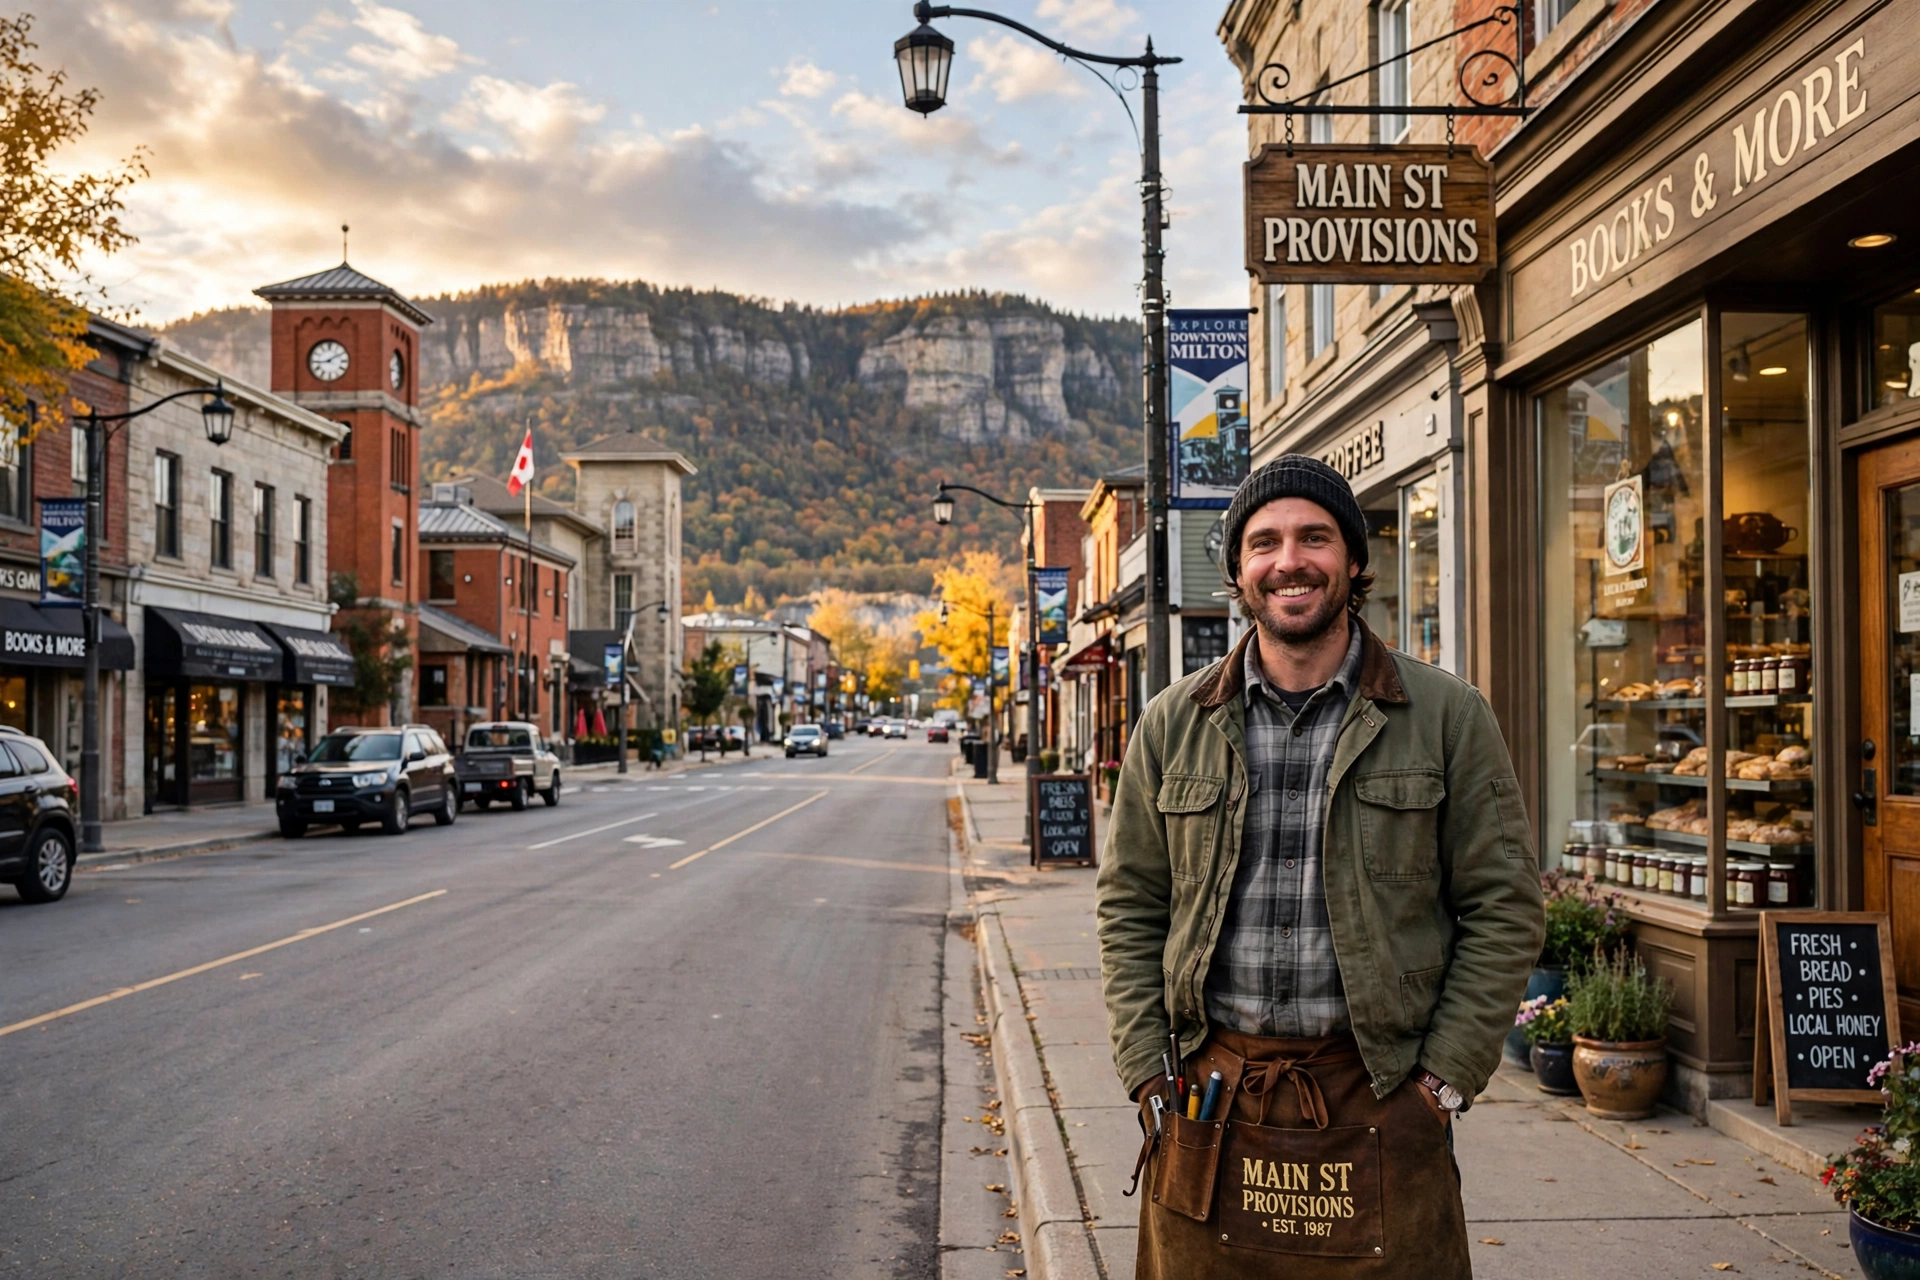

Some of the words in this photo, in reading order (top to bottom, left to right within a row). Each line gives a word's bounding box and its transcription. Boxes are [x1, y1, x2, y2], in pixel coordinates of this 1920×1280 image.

[1690, 152, 1717, 219] &
[1732, 36, 1868, 197] MORE
[1296, 163, 1391, 208] MAIN
[1403, 164, 1448, 209] ST
[1264, 217, 1479, 263] PROVISIONS
[1170, 320, 1247, 331] EXPLORE
[1170, 332, 1247, 343] DOWNTOWN
[1170, 344, 1247, 359] MILTON
[5, 630, 43, 654] BOOKS
[45, 634, 54, 655] &
[56, 636, 86, 657] MORE
[1790, 933, 1842, 956] FRESH
[1800, 960, 1852, 982] BREAD
[1808, 986, 1844, 1009] PIES
[1789, 1013, 1833, 1035] LOCAL
[1836, 1015, 1880, 1037] HONEY
[1810, 1045, 1856, 1069] OPEN
[1242, 1157, 1309, 1191] MAIN
[1320, 1162, 1353, 1192] ST
[1242, 1189, 1355, 1218] PROVISIONS
[1272, 1219, 1299, 1235] EST.
[1304, 1222, 1333, 1237] 1987
